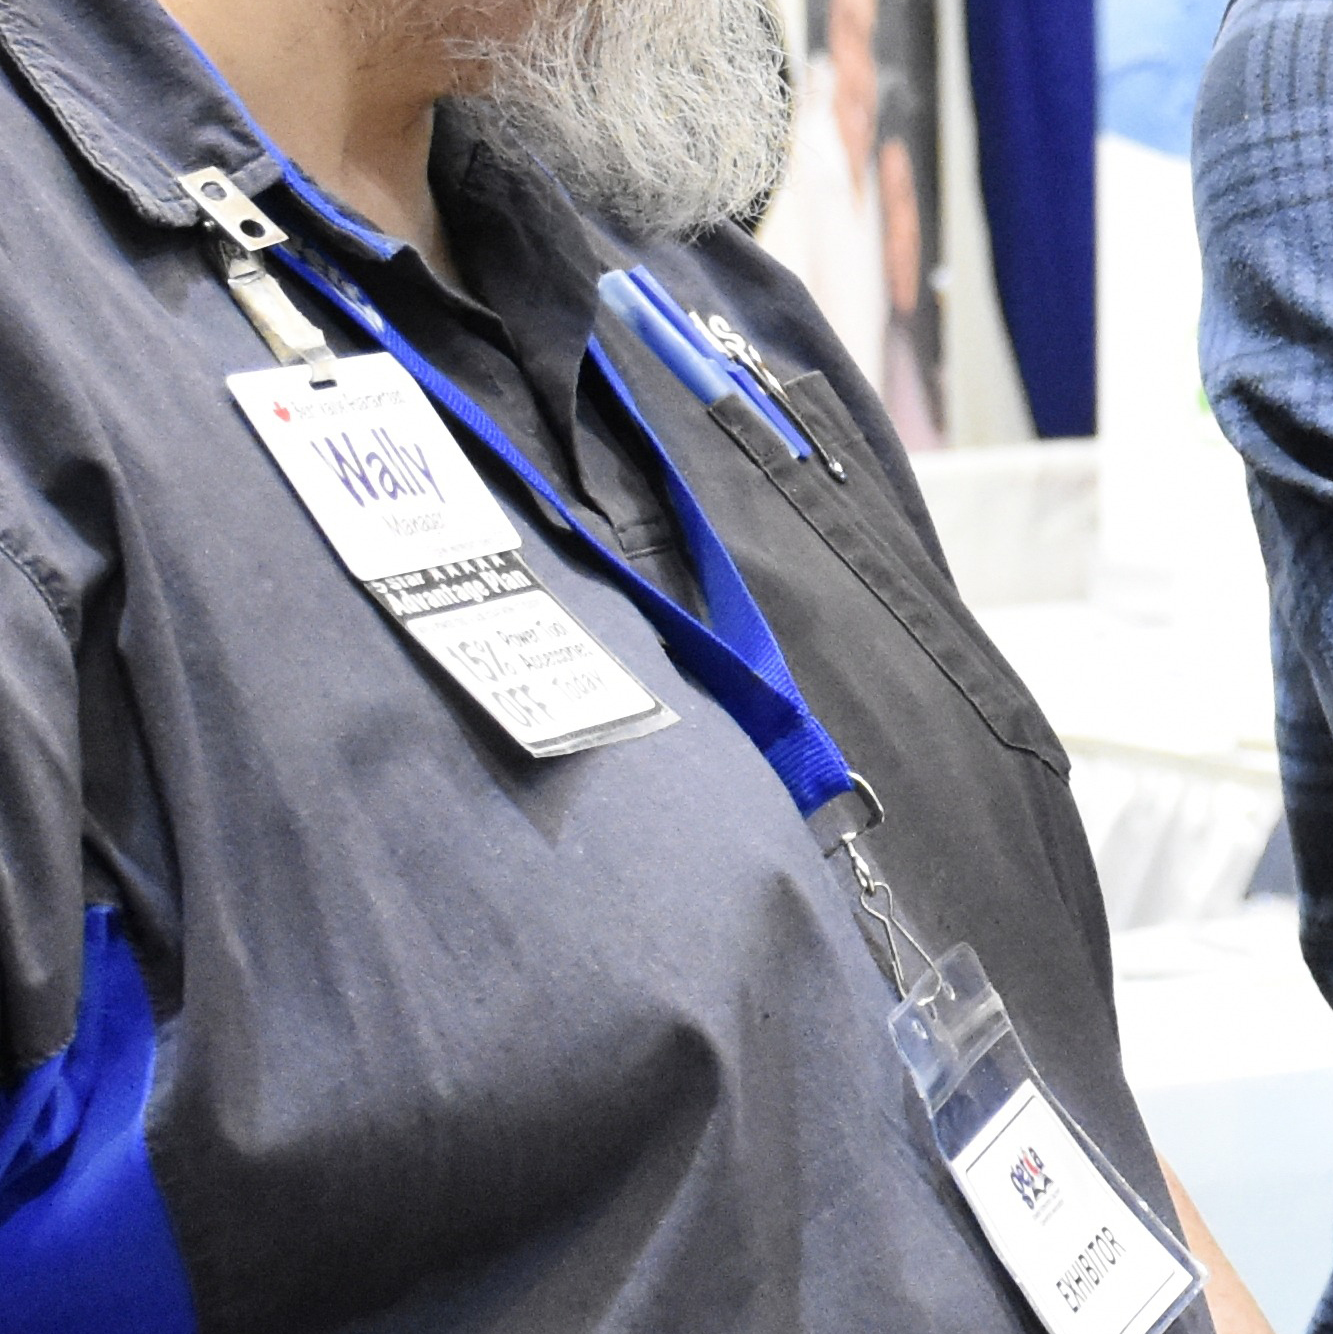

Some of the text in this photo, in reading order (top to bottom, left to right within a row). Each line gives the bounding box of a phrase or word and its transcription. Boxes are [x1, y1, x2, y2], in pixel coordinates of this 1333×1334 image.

[310, 427, 446, 507] Wally
[384, 578, 490, 617] Advantage
[480, 568, 533, 593] Plan
[496, 620, 569, 648] Power Tool
[446, 639, 518, 682] 15%
[491, 684, 556, 728] OFF
[552, 670, 609, 703] Today
[1056, 1226, 1127, 1313] EXHIBITOR
